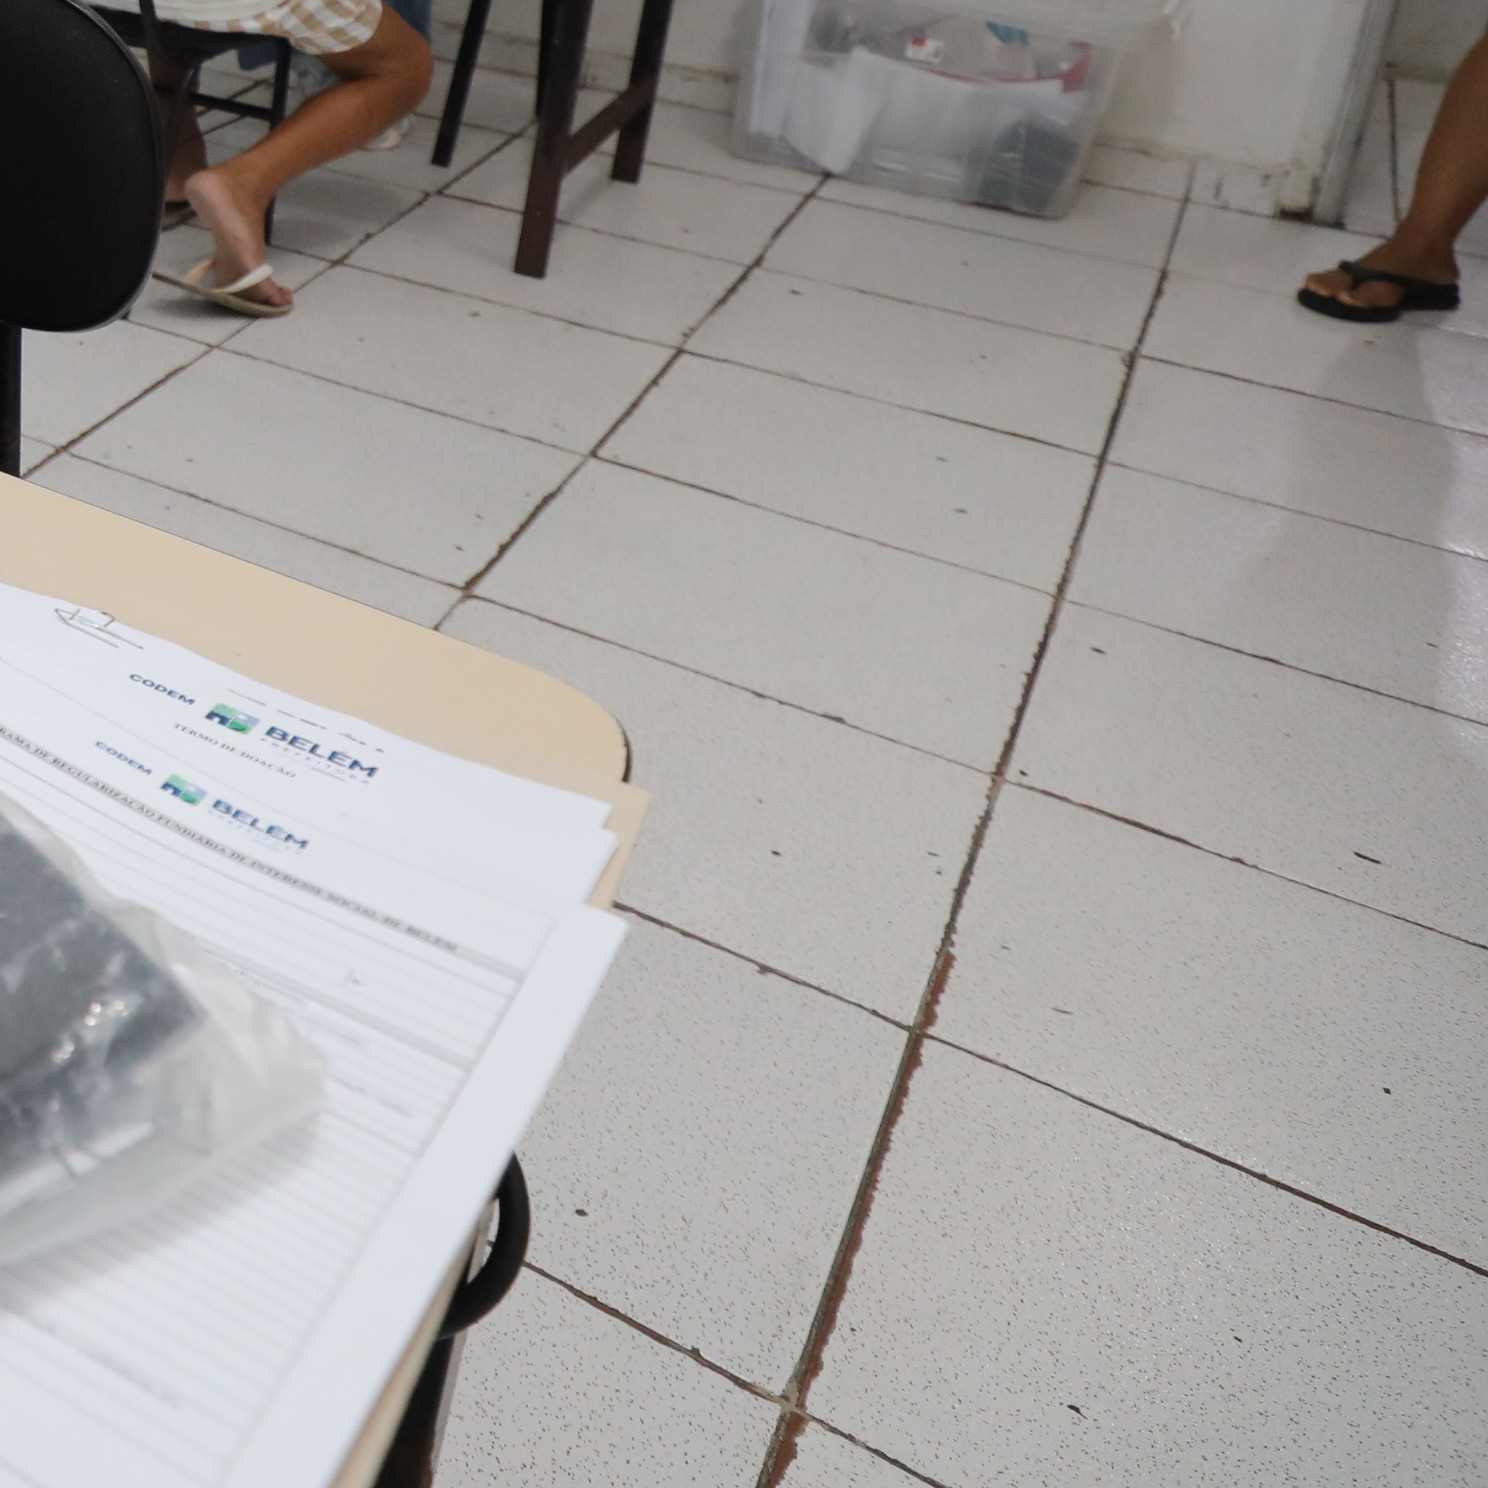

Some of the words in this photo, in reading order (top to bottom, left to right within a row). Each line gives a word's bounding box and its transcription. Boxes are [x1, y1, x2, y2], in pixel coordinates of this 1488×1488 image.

[129, 673, 196, 706] CODEM
[95, 740, 153, 776] CODEM
[174, 722, 218, 746] TERMO
[220, 742, 238, 754] DE
[239, 749, 296, 780] DOAÇÃO
[264, 725, 380, 779] BELÉM
[34, 747, 50, 760] DE
[53, 757, 156, 819] REGULARIZAÇÃO
[158, 813, 226, 856] FUNDIÁRIA
[230, 850, 246, 863] DE
[211, 798, 310, 850] BELÉM
